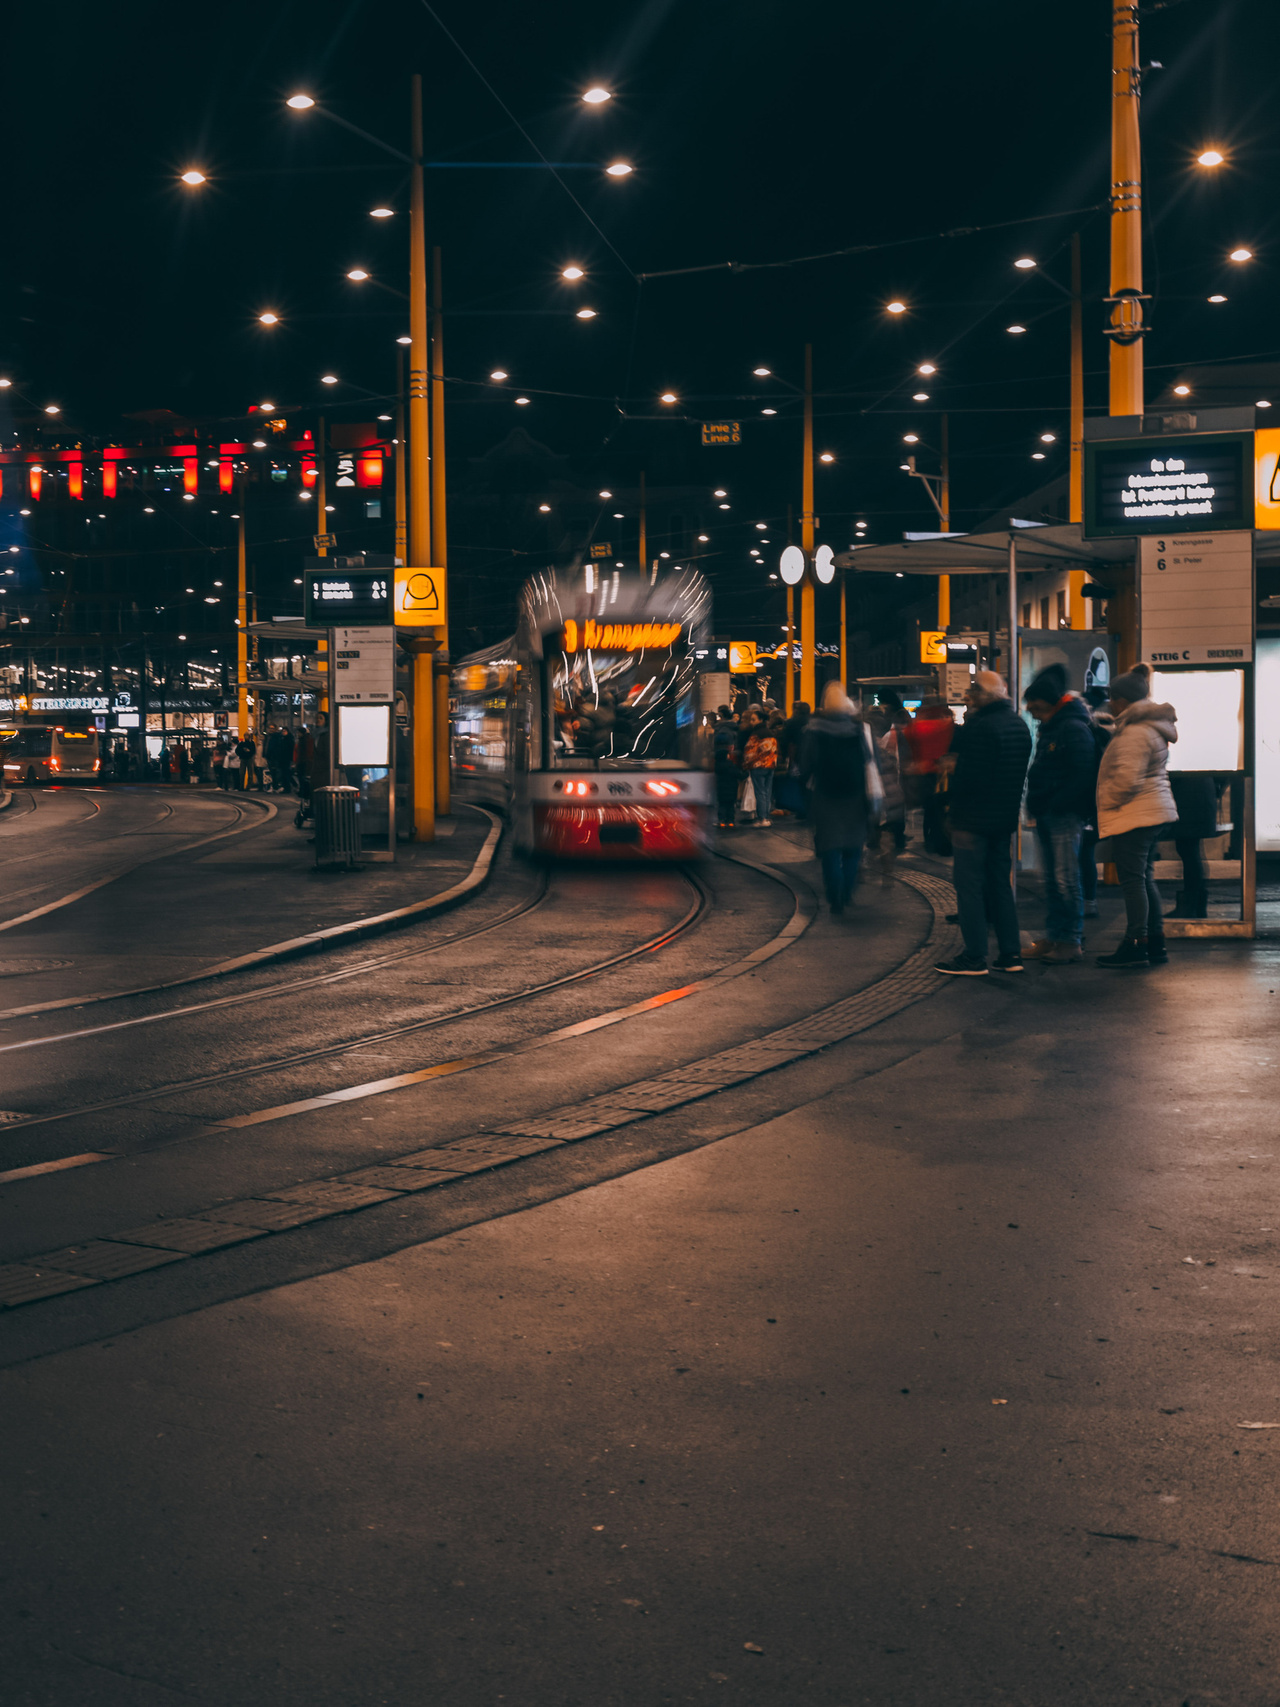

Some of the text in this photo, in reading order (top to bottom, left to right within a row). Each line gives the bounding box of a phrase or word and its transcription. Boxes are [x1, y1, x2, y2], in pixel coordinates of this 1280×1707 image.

[703, 422, 740, 433] Linie 3
[703, 432, 740, 443] Linie 6
[1157, 540, 1166, 553] 3
[1157, 558, 1166, 571] 6
[1151, 650, 1190, 661] STEIG C
